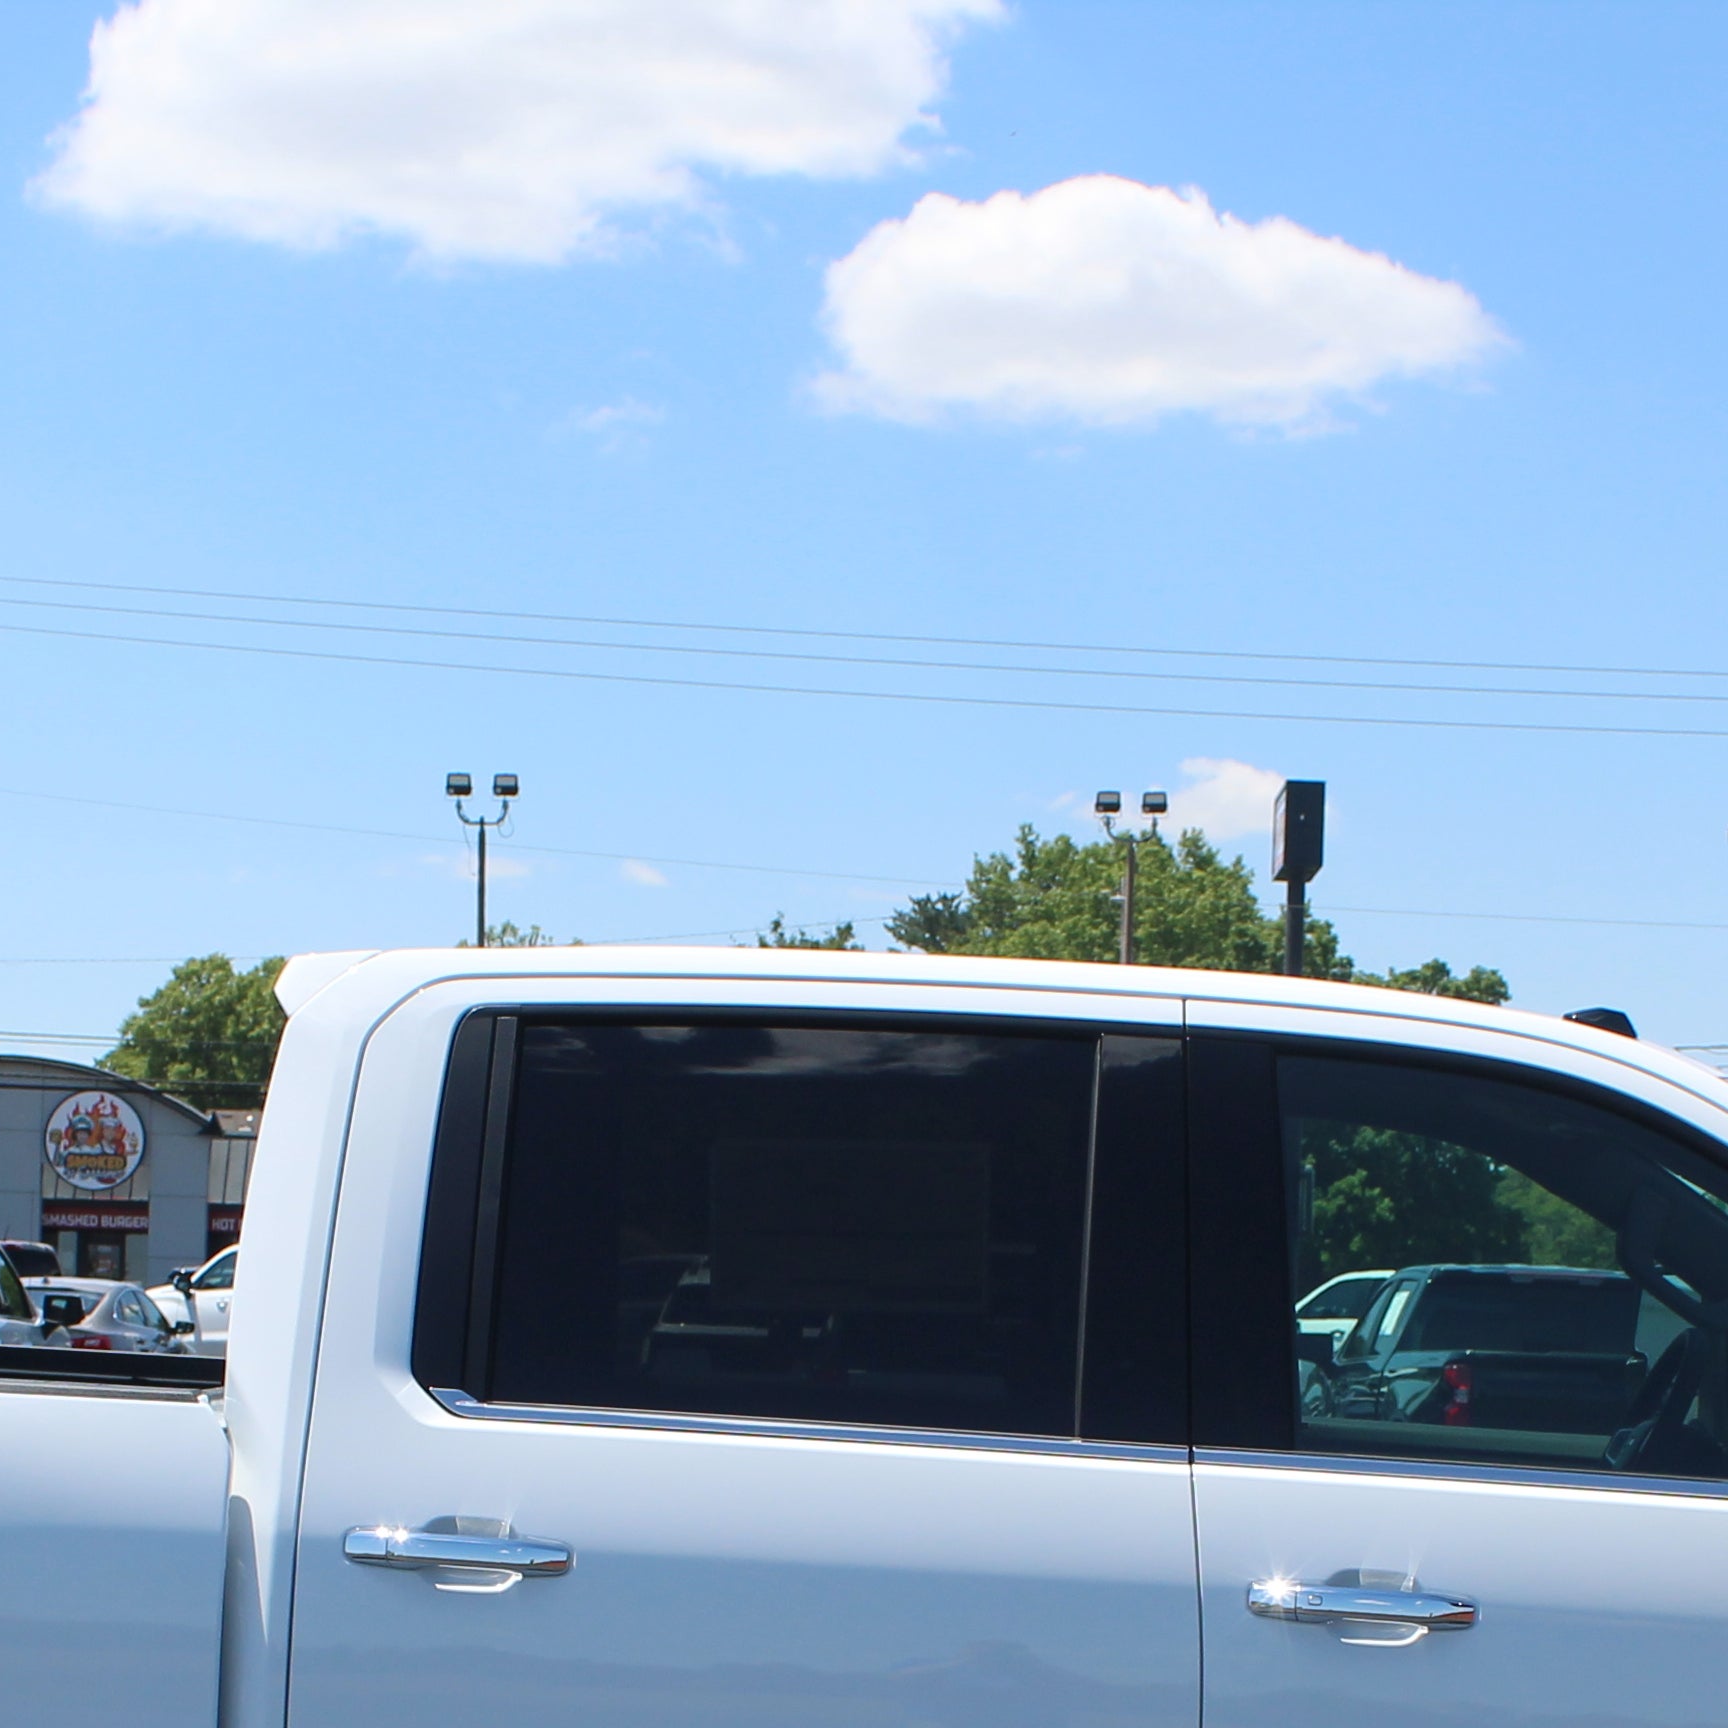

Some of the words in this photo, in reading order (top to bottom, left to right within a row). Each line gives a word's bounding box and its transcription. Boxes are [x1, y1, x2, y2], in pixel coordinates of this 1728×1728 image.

[42, 1213, 98, 1228] SMASHED
[100, 1214, 148, 1229] BURGER
[212, 1219, 235, 1232] HOT
